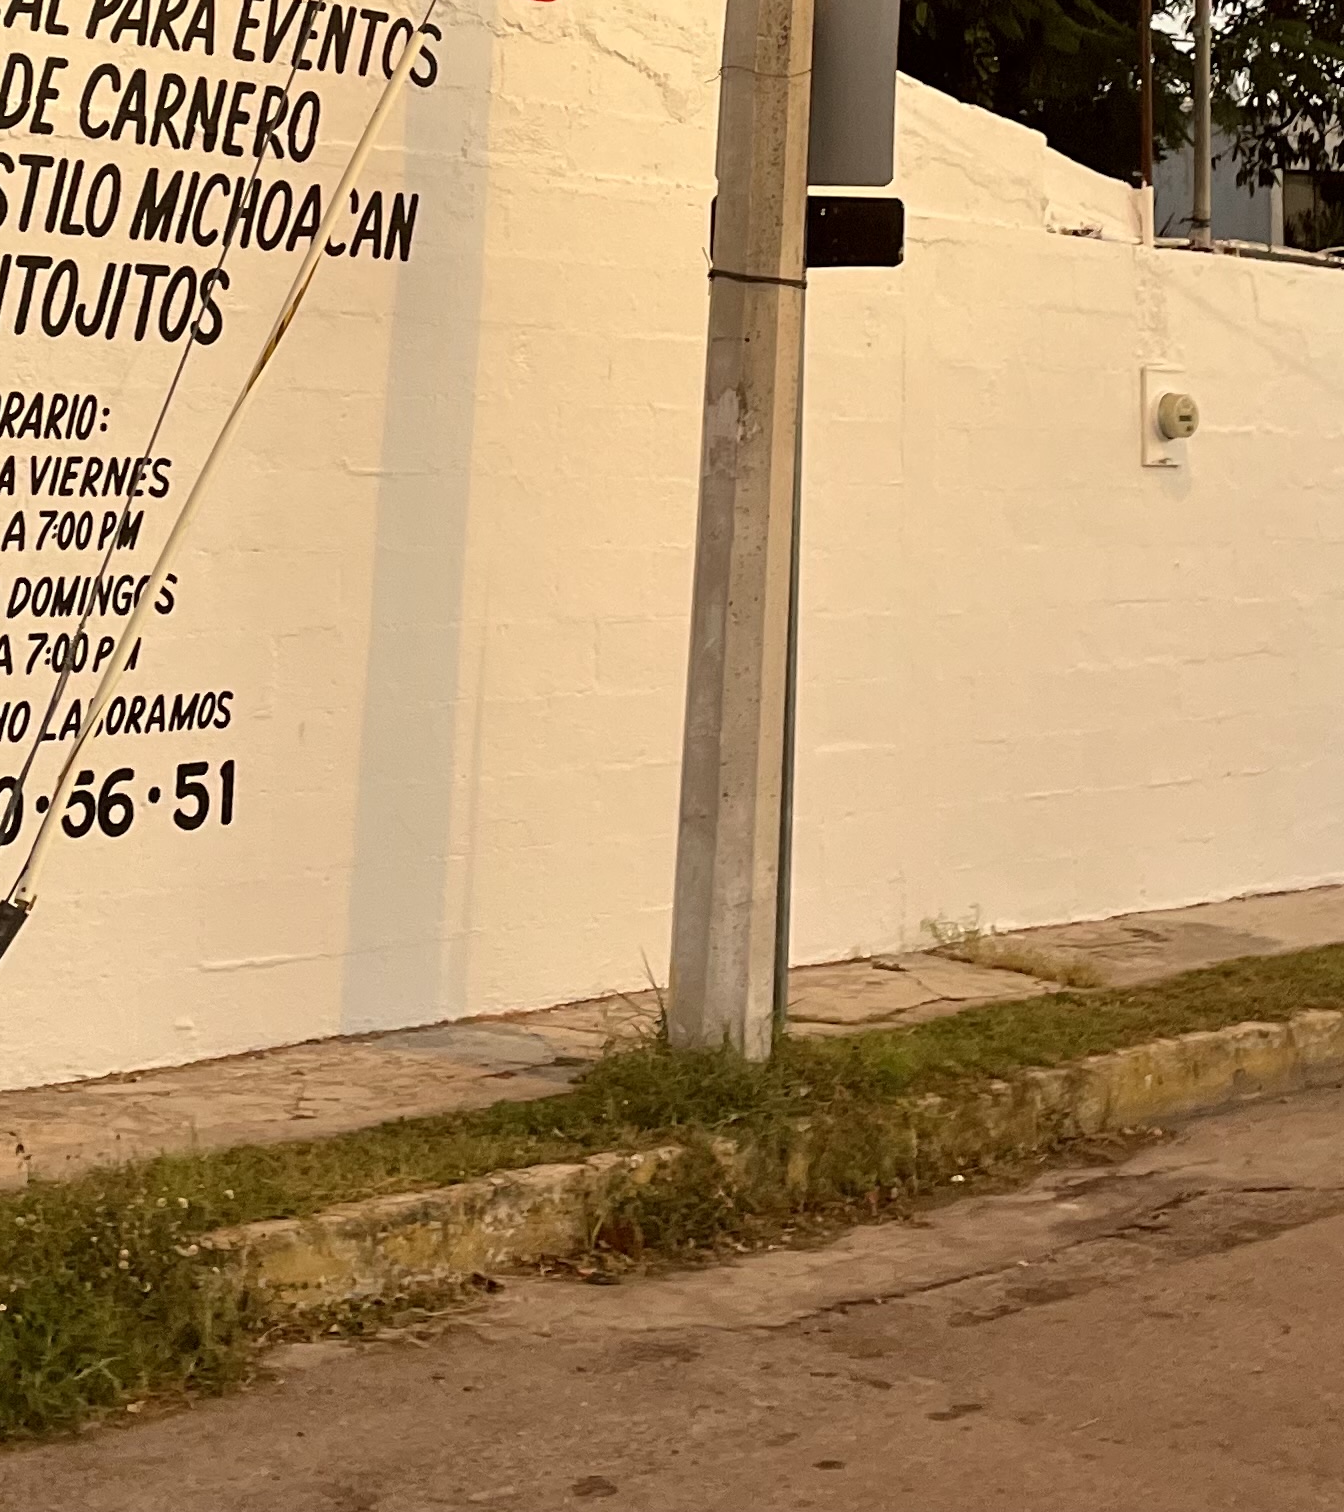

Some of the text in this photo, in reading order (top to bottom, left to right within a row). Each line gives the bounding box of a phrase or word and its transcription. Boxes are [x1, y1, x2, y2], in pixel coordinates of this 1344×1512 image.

[80, 64, 320, 163] CARNERO
[31, 456, 172, 498] VIERNES
[1, 511, 26, 551] A
